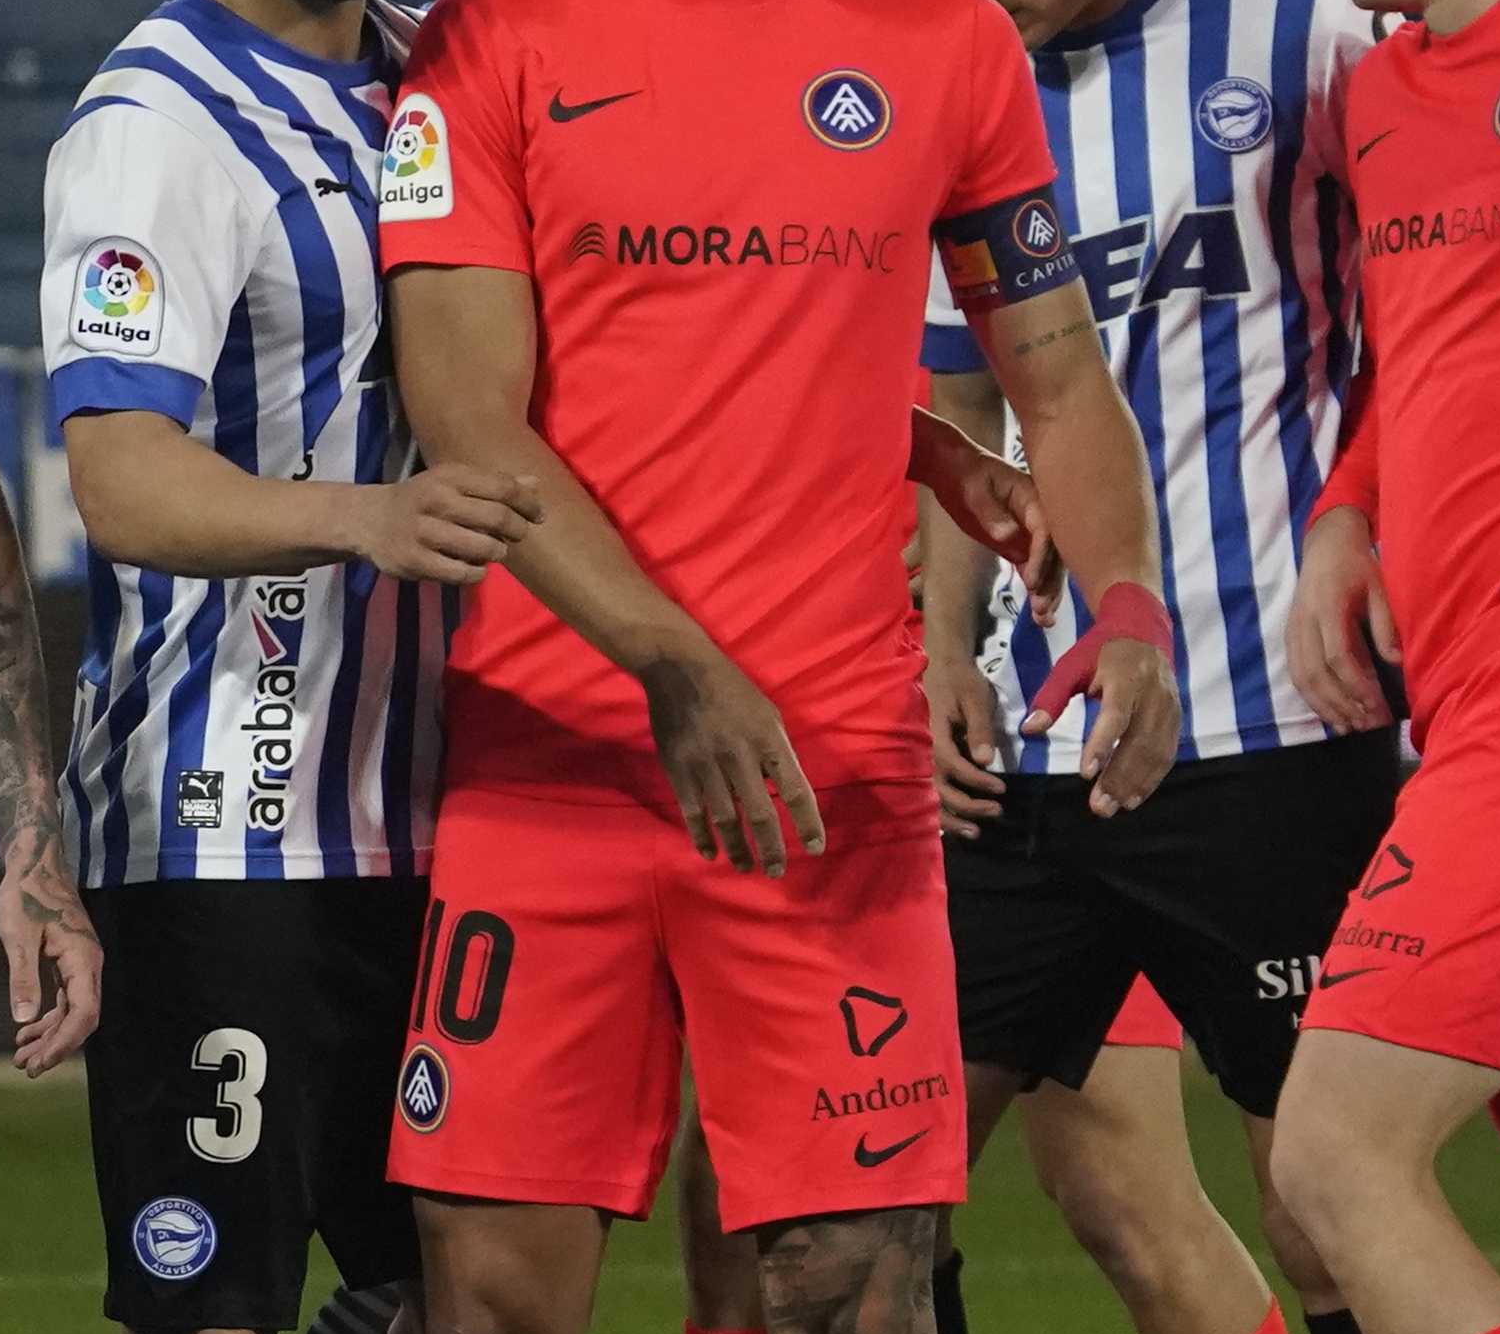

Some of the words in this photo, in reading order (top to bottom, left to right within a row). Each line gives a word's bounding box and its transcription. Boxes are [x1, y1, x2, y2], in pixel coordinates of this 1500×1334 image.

[617, 223, 903, 273] MORABANC
[1069, 209, 1251, 323] EA
[77, 318, 151, 343] LaLiga
[240, 669, 297, 827] araba
[411, 898, 517, 1046] 10
[185, 1027, 270, 1163] 3
[810, 1072, 951, 1121] Andorra
[147, 1201, 203, 1221] DEPORTIVO
